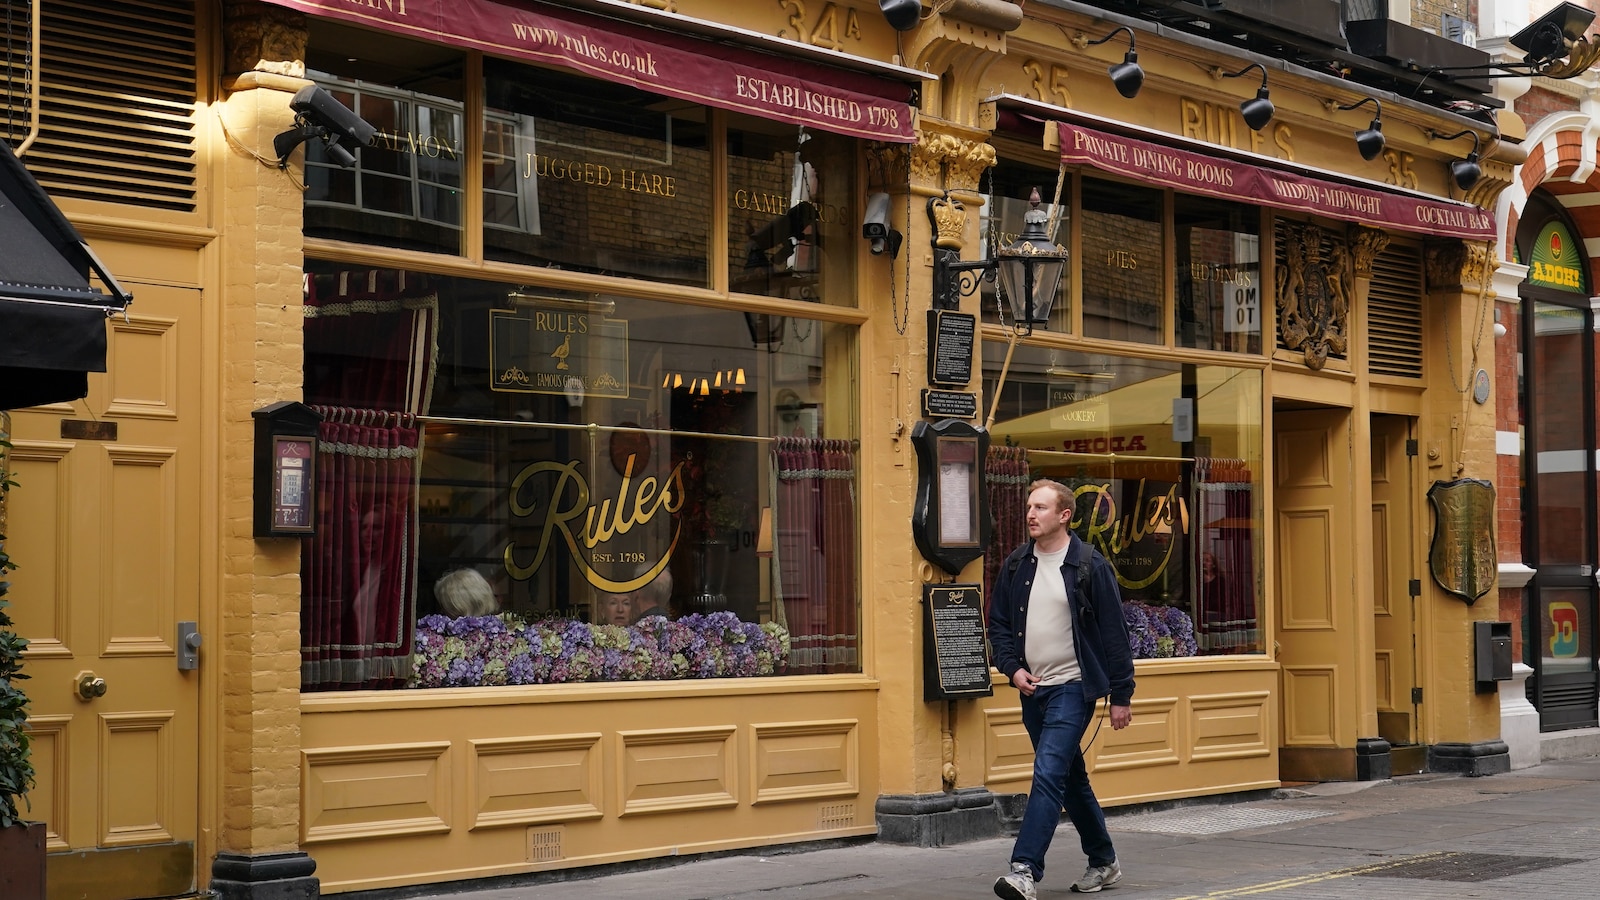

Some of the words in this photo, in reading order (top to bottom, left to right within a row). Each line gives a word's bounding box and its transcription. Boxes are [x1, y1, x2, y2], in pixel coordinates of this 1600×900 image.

[511, 22, 659, 78] www.rules.co.uk
[1023, 59, 1072, 109] 35
[735, 74, 862, 123] ESTABLISHED
[867, 105, 899, 129] 1798
[1073, 129, 1130, 164] PRIVATE
[1133, 147, 1183, 177] DINING
[1187, 159, 1234, 187] ROOMS
[523, 152, 612, 188] JUGGED
[620, 168, 677, 198] HARE
[734, 188, 788, 216] GAME
[1272, 178, 1382, 215] MIDDAY-MIDNIGHT
[1415, 204, 1468, 229] COCKTAIL
[1469, 213, 1491, 230] BAR
[1106, 249, 1138, 271] PIES
[1533, 261, 1580, 288] ADOH!
[537, 372, 562, 387] FAMOUS
[563, 374, 589, 390] GROUSE
[1062, 410, 1097, 422] COOKERY
[504, 453, 686, 593] Rules
[1070, 477, 1178, 590] Rules
[592, 552, 615, 563] EST.
[619, 552, 646, 563] 1798
[1135, 557, 1153, 567] 1798
